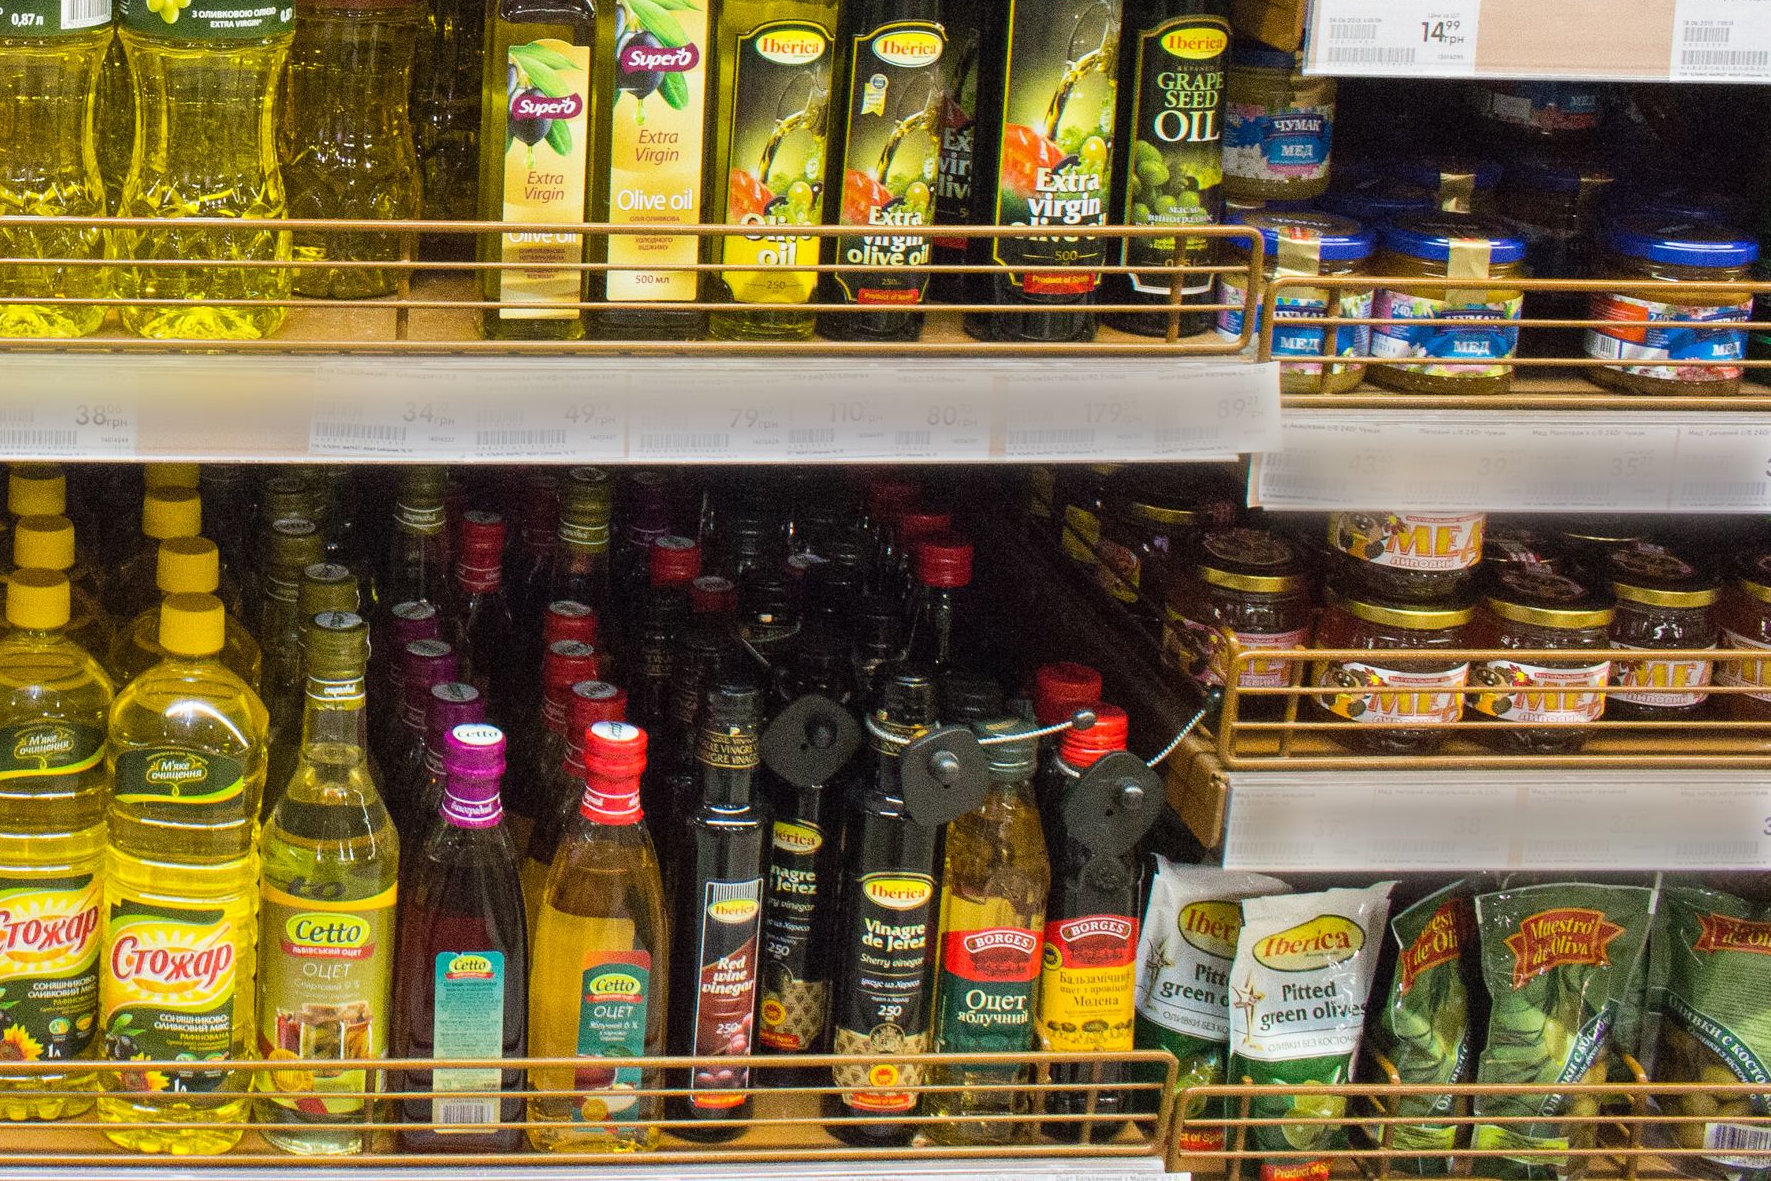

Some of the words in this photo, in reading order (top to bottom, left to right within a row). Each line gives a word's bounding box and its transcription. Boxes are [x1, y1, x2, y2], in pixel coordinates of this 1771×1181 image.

[11, 13, 35, 26] 0,87
[1421, 21, 1445, 42] 14
[1445, 20, 1461, 31] 99
[762, 36, 820, 55] Ibérica
[881, 39, 937, 56] Ibérica
[628, 49, 692, 70] Supero
[1158, 71, 1224, 91] GRAPE
[1165, 90, 1218, 109] SEED
[1155, 110, 1220, 143] OIL
[638, 130, 679, 144] Extra
[635, 146, 680, 163] Virgin
[1281, 144, 1314, 158] МЕД
[527, 171, 564, 185] Extra
[1035, 167, 1100, 192] Extra
[524, 186, 565, 202] Virgin
[617, 189, 667, 211] Olive
[669, 188, 693, 210] oil
[1027, 195, 1101, 224] virgin
[635, 274, 654, 285] 500
[655, 276, 670, 285] мл
[1453, 340, 1491, 356] МЕД
[457, 729, 498, 740] Cetto
[161, 760, 190, 771] М'яке
[152, 768, 203, 780] очищення
[871, 884, 926, 900] Ibérica
[295, 918, 361, 944] Cetto
[864, 918, 926, 936] Vinagre
[1071, 920, 1125, 935] BORGES
[862, 933, 882, 947] de
[887, 932, 926, 953] Jerez
[974, 934, 1030, 950] BORGES
[293, 946, 341, 957] ЛЬВІВСЬКИЙ
[343, 947, 362, 956] ОЦЕТ
[113, 934, 232, 989] Стожар
[717, 956, 746, 970] Red
[303, 962, 351, 978] ОЦЕТ
[713, 969, 746, 982] wine
[595, 978, 636, 993] Cetto
[702, 981, 754, 997] vinegar
[1282, 982, 1337, 1001] Pitted
[965, 989, 1027, 1012] Оцет
[594, 1006, 633, 1019] ОЦЕТ
[878, 1006, 902, 1017] 250
[957, 1009, 1029, 1026] яблучний
[1261, 1010, 1309, 1032] green
[1313, 1001, 1368, 1023] olives
